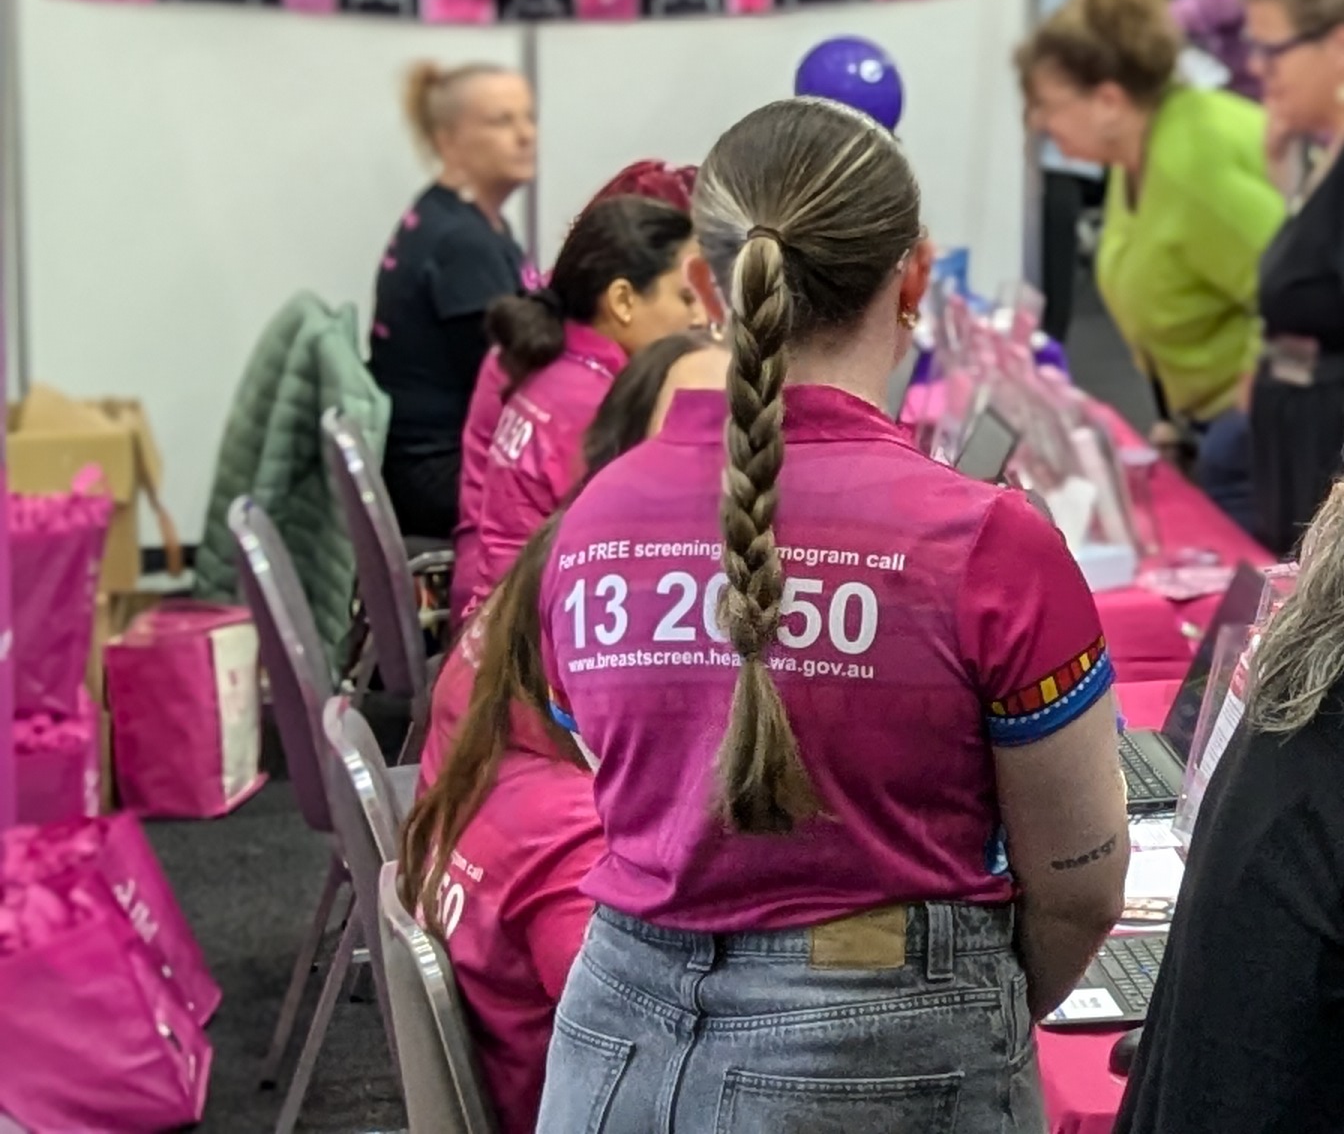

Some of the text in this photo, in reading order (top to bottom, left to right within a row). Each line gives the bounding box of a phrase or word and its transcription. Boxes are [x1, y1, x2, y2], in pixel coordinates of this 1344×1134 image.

[558, 540, 906, 572] For a FREE screening mogram call
[564, 573, 629, 649] 13
[776, 577, 878, 655] 50
